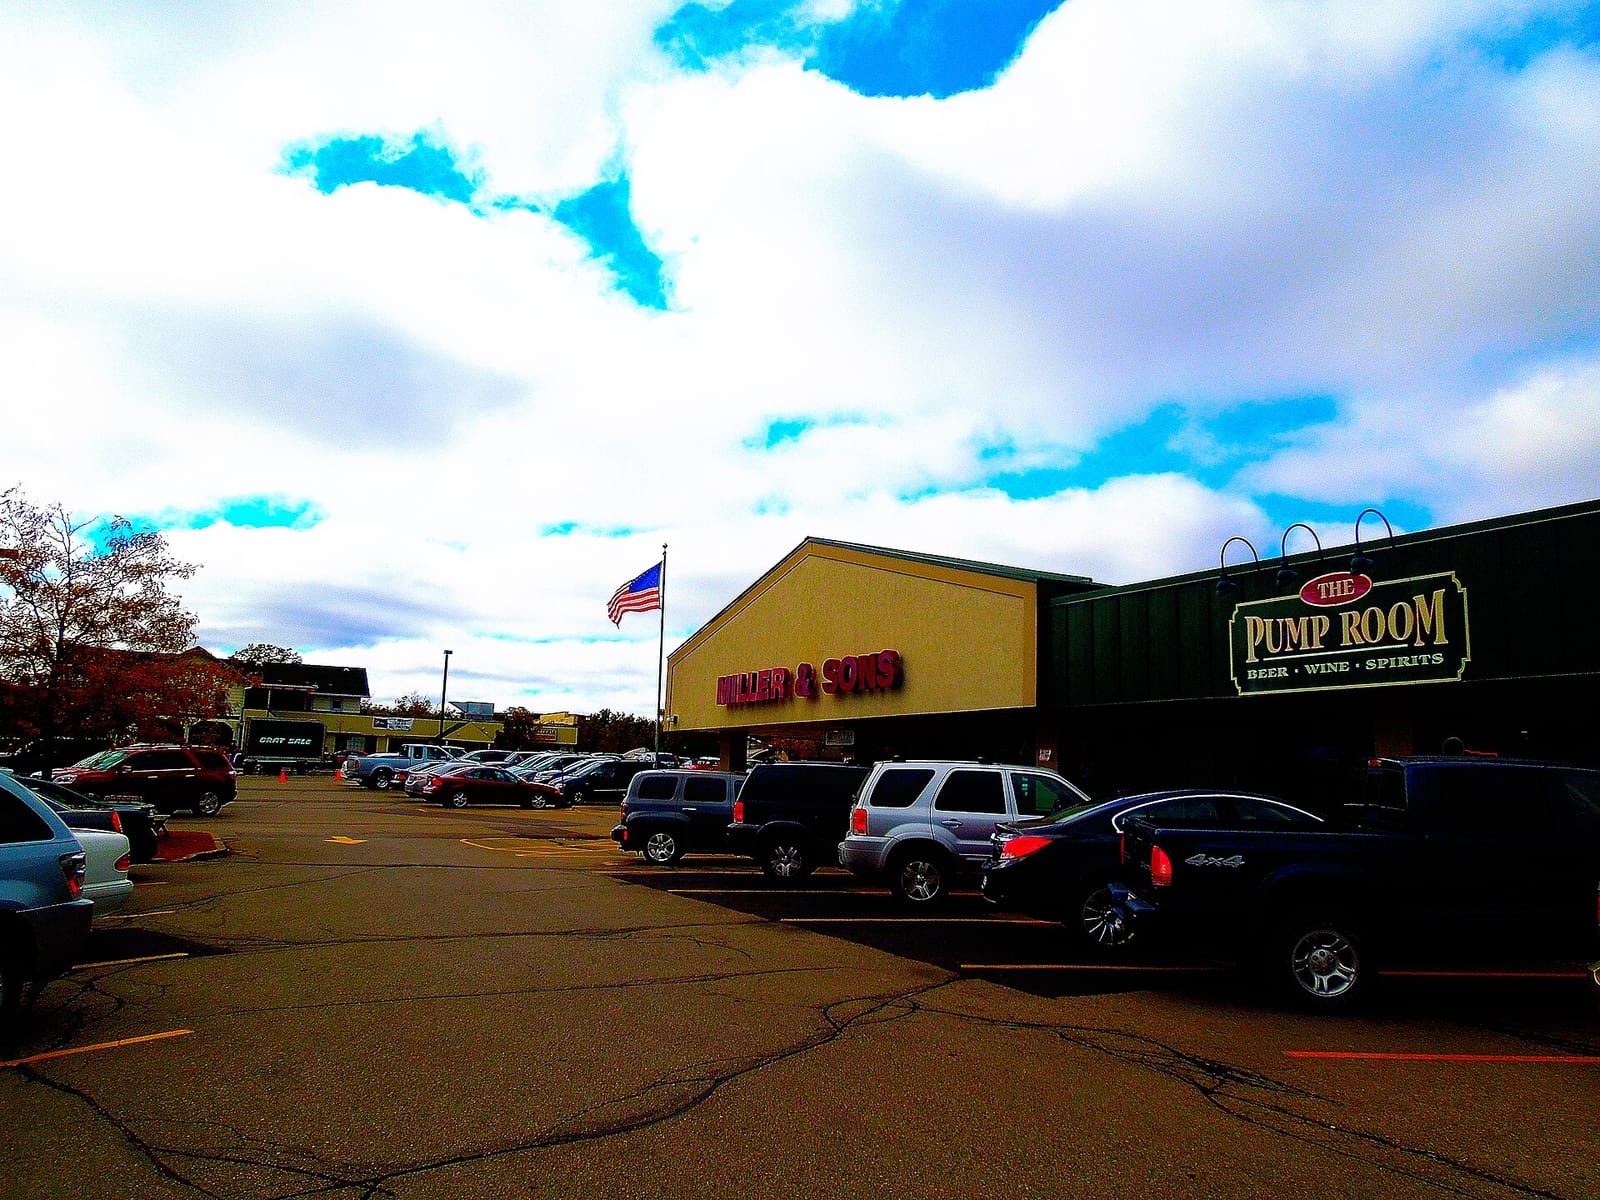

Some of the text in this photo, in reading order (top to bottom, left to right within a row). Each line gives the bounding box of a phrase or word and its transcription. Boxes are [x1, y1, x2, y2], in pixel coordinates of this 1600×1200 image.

[1317, 579, 1355, 599] THE
[1244, 589, 1449, 663] PUMP ROOM
[717, 649, 900, 706] MILLER & SONS
[1247, 653, 1444, 680] BEER WINE SPIRITS
